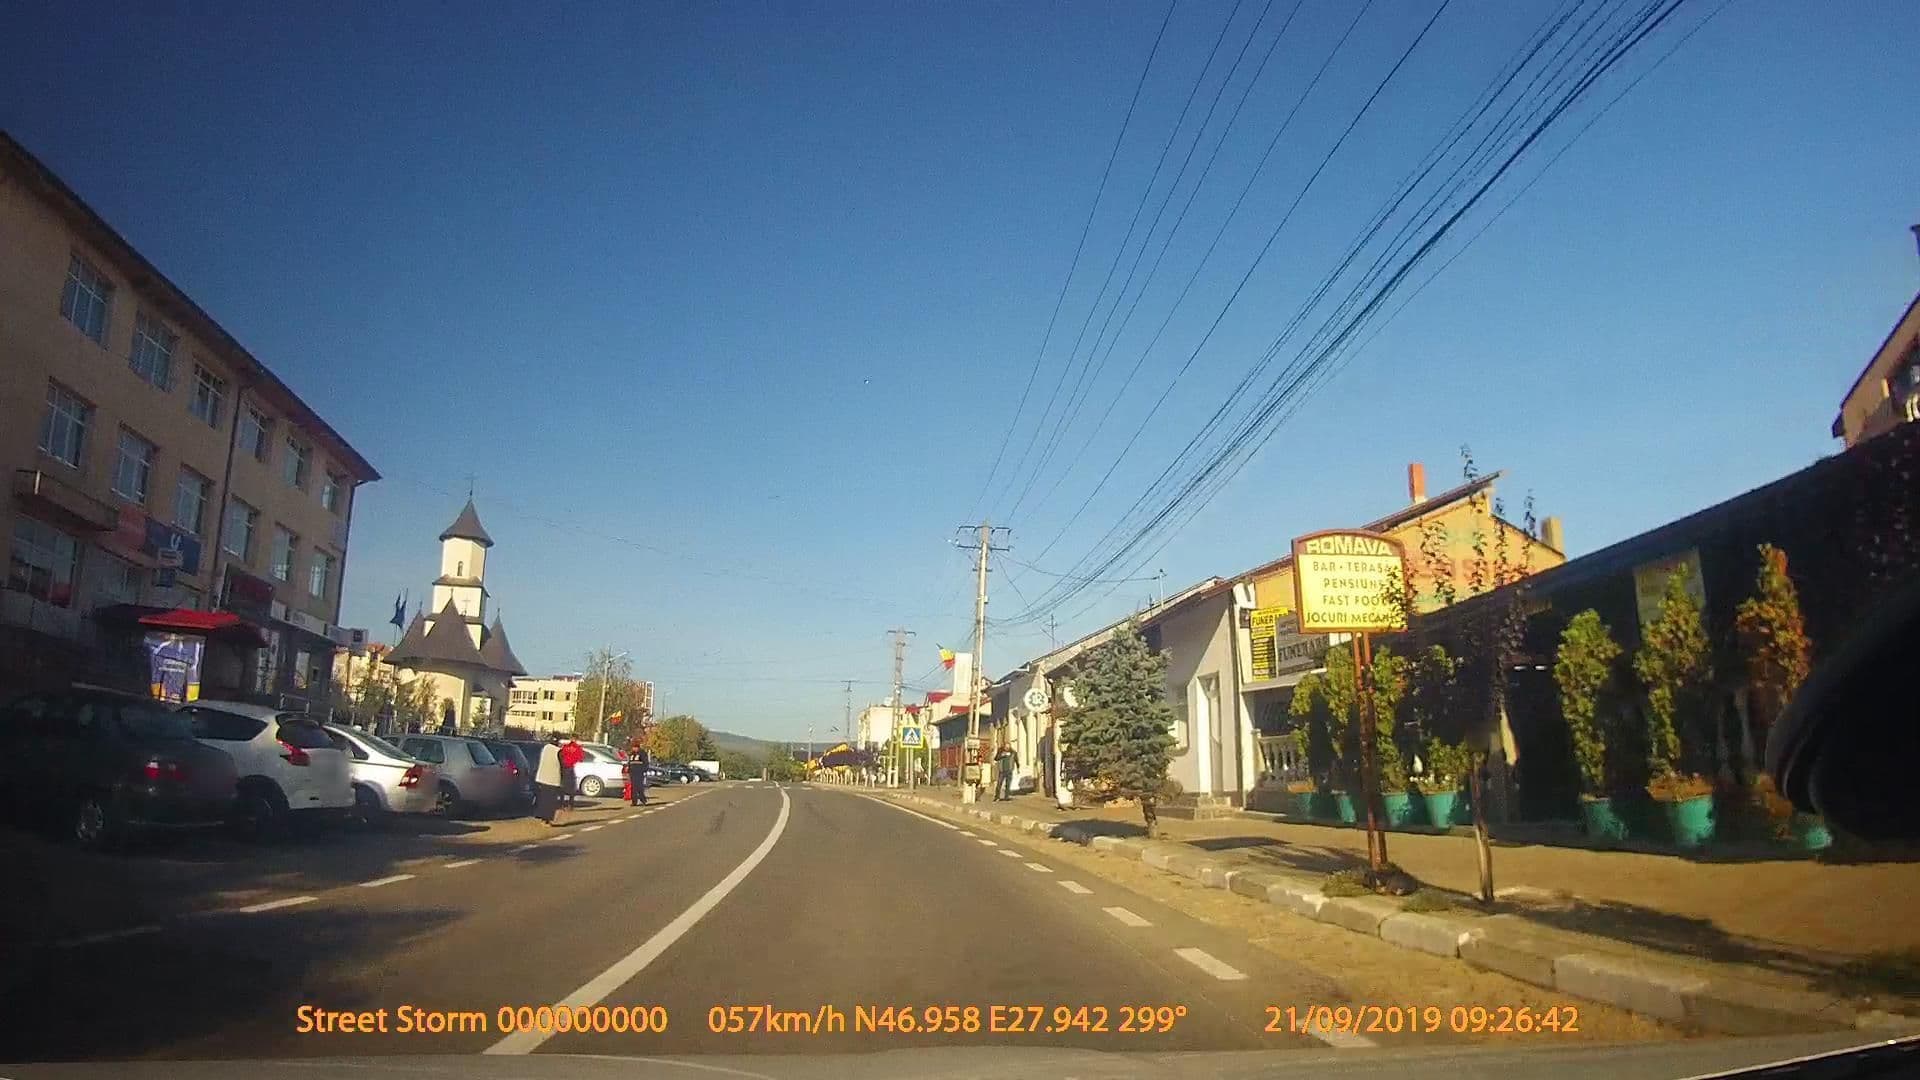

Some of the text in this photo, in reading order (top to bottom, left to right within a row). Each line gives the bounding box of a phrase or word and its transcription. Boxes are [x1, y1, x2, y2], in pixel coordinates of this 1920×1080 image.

[1313, 561, 1336, 572] BAR
[1323, 595, 1350, 606] FAST
[1306, 612, 1347, 624] JOCURI
